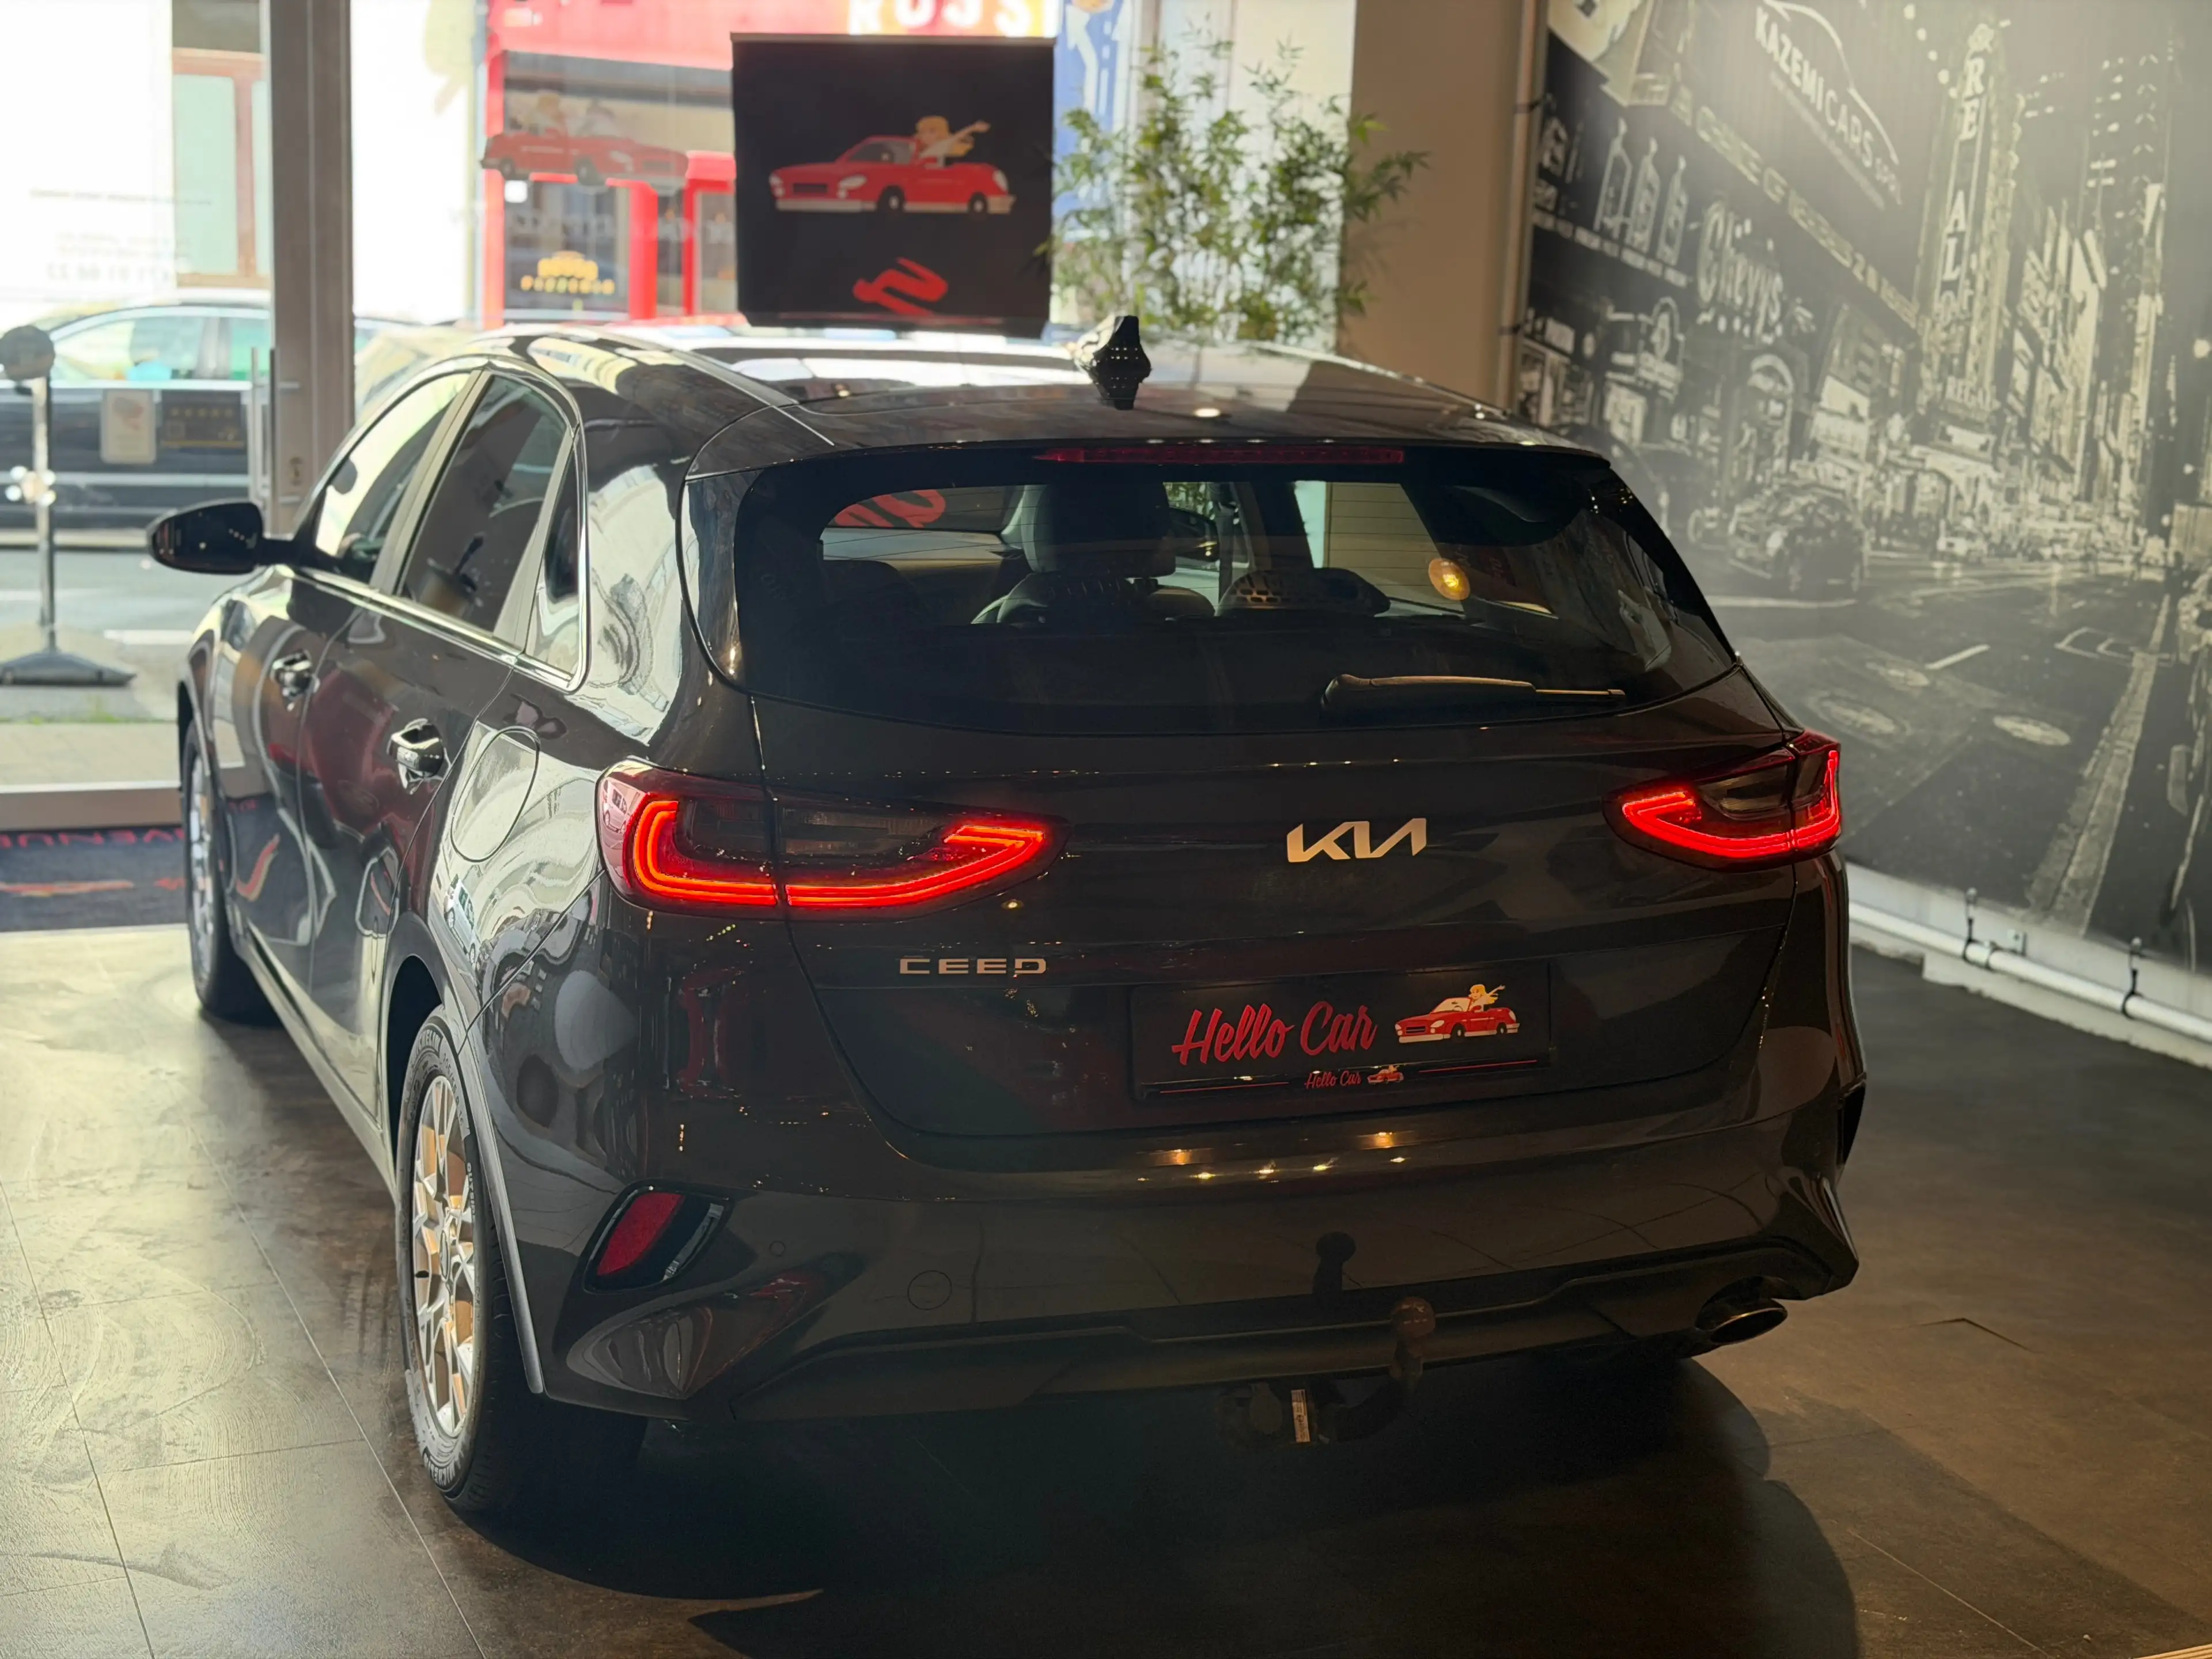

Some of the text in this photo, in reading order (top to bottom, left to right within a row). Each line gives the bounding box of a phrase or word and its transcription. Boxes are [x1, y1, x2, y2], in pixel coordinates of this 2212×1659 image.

[1755, 7, 1825, 112] KAZEMI
[1824, 88, 1874, 169] CARS
[1696, 199, 1785, 340] Chevys
[1286, 817, 1427, 863] KIA
[899, 957, 1047, 975] CEED
[1172, 1001, 1378, 1066] Hello Car
[1304, 1070, 1362, 1090] Hello Car
